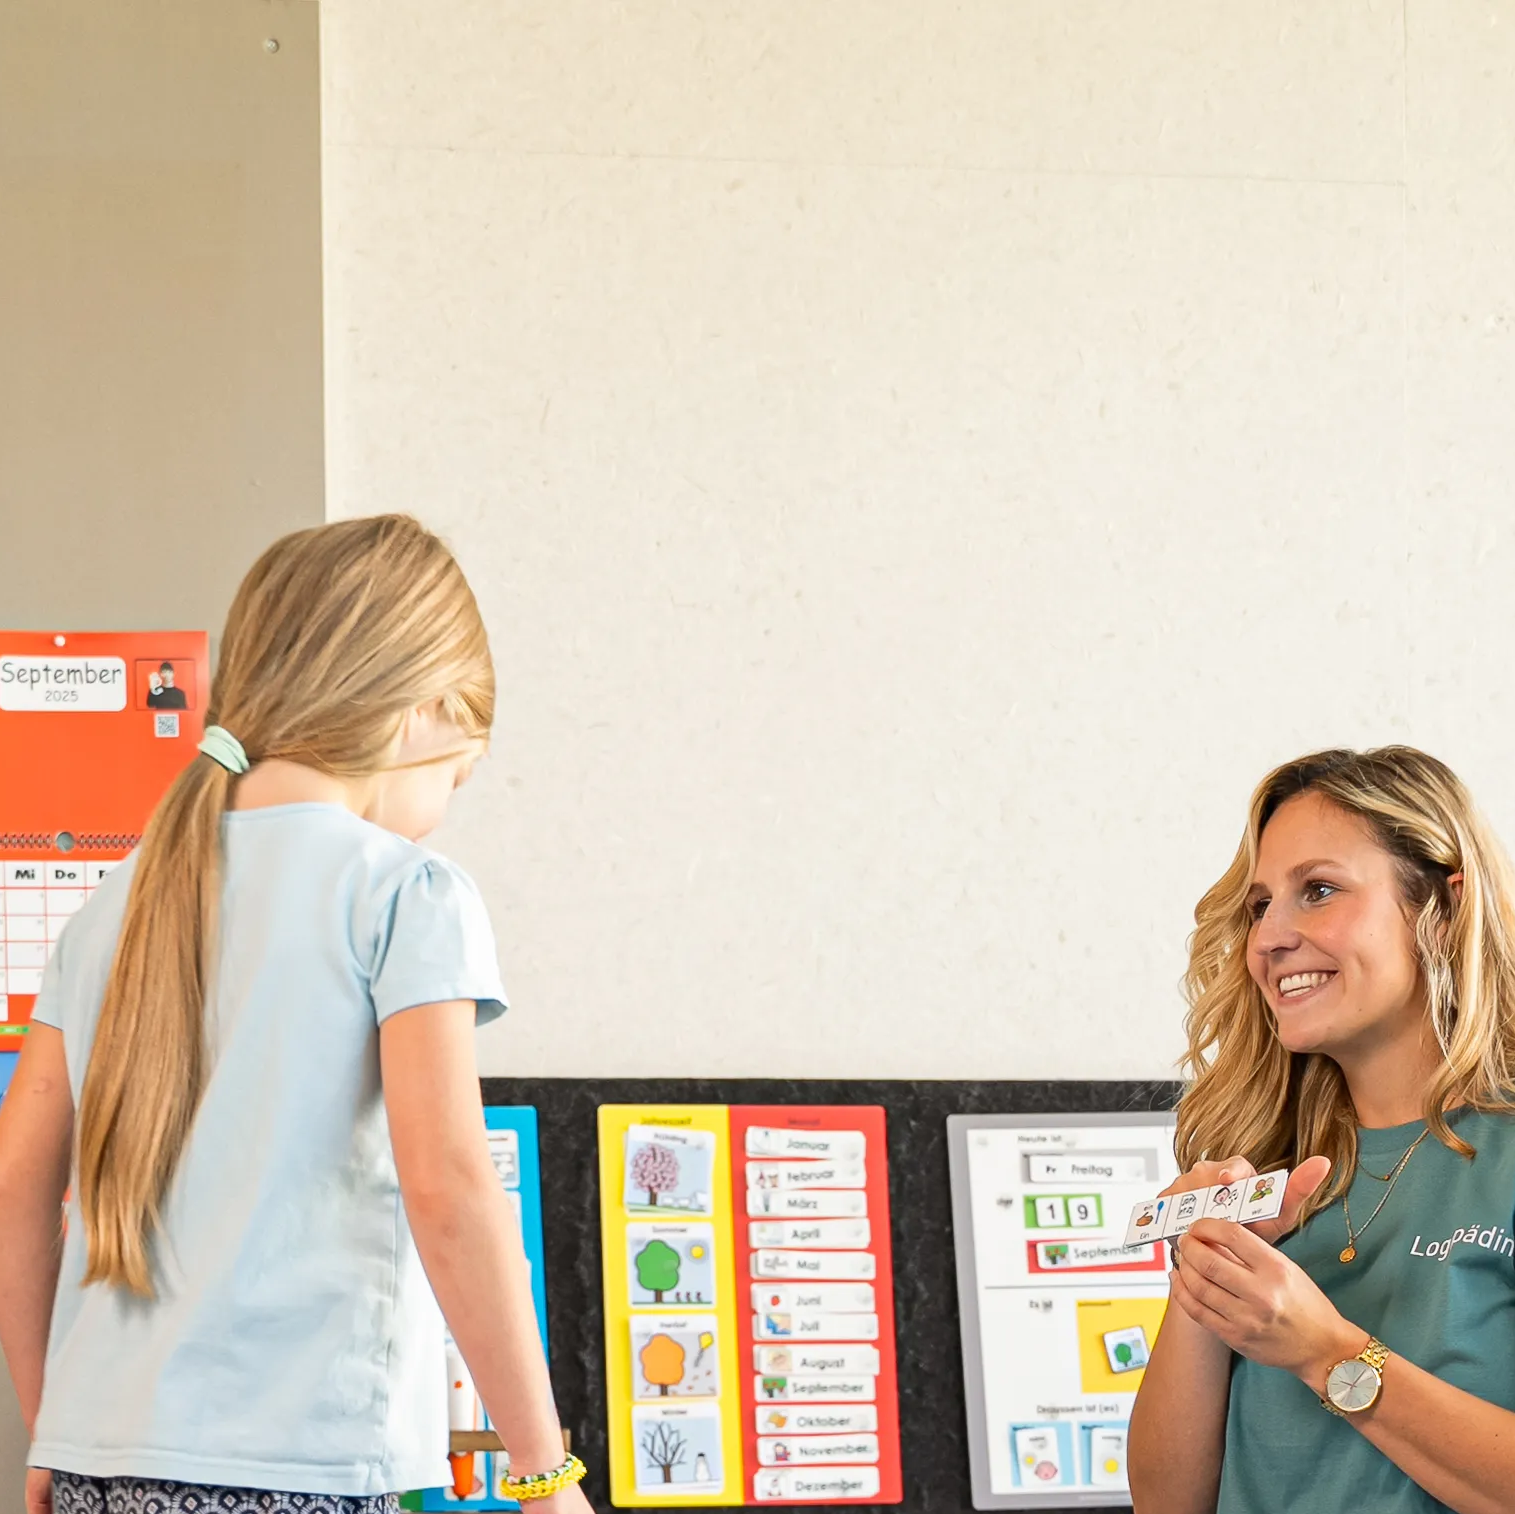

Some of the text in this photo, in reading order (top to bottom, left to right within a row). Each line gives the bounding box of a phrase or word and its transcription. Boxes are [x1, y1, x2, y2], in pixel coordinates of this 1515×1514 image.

[0, 661, 123, 691] September
[44, 690, 79, 703] 2025
[15, 869, 36, 880] Mi
[54, 869, 77, 880] Do
[1071, 1164, 1114, 1176] Freitag
[1047, 1204, 1088, 1220] 1 9
[791, 1228, 821, 1241] April
[1409, 1224, 1515, 1262] Logpädin
[1073, 1246, 1144, 1259] September
[796, 1260, 820, 1271] Mai
[796, 1296, 822, 1307] Juni
[800, 1357, 846, 1371] August
[792, 1382, 864, 1394] September
[796, 1416, 851, 1428] Oktober
[799, 1442, 869, 1457] November
[794, 1479, 864, 1493] Dezember
